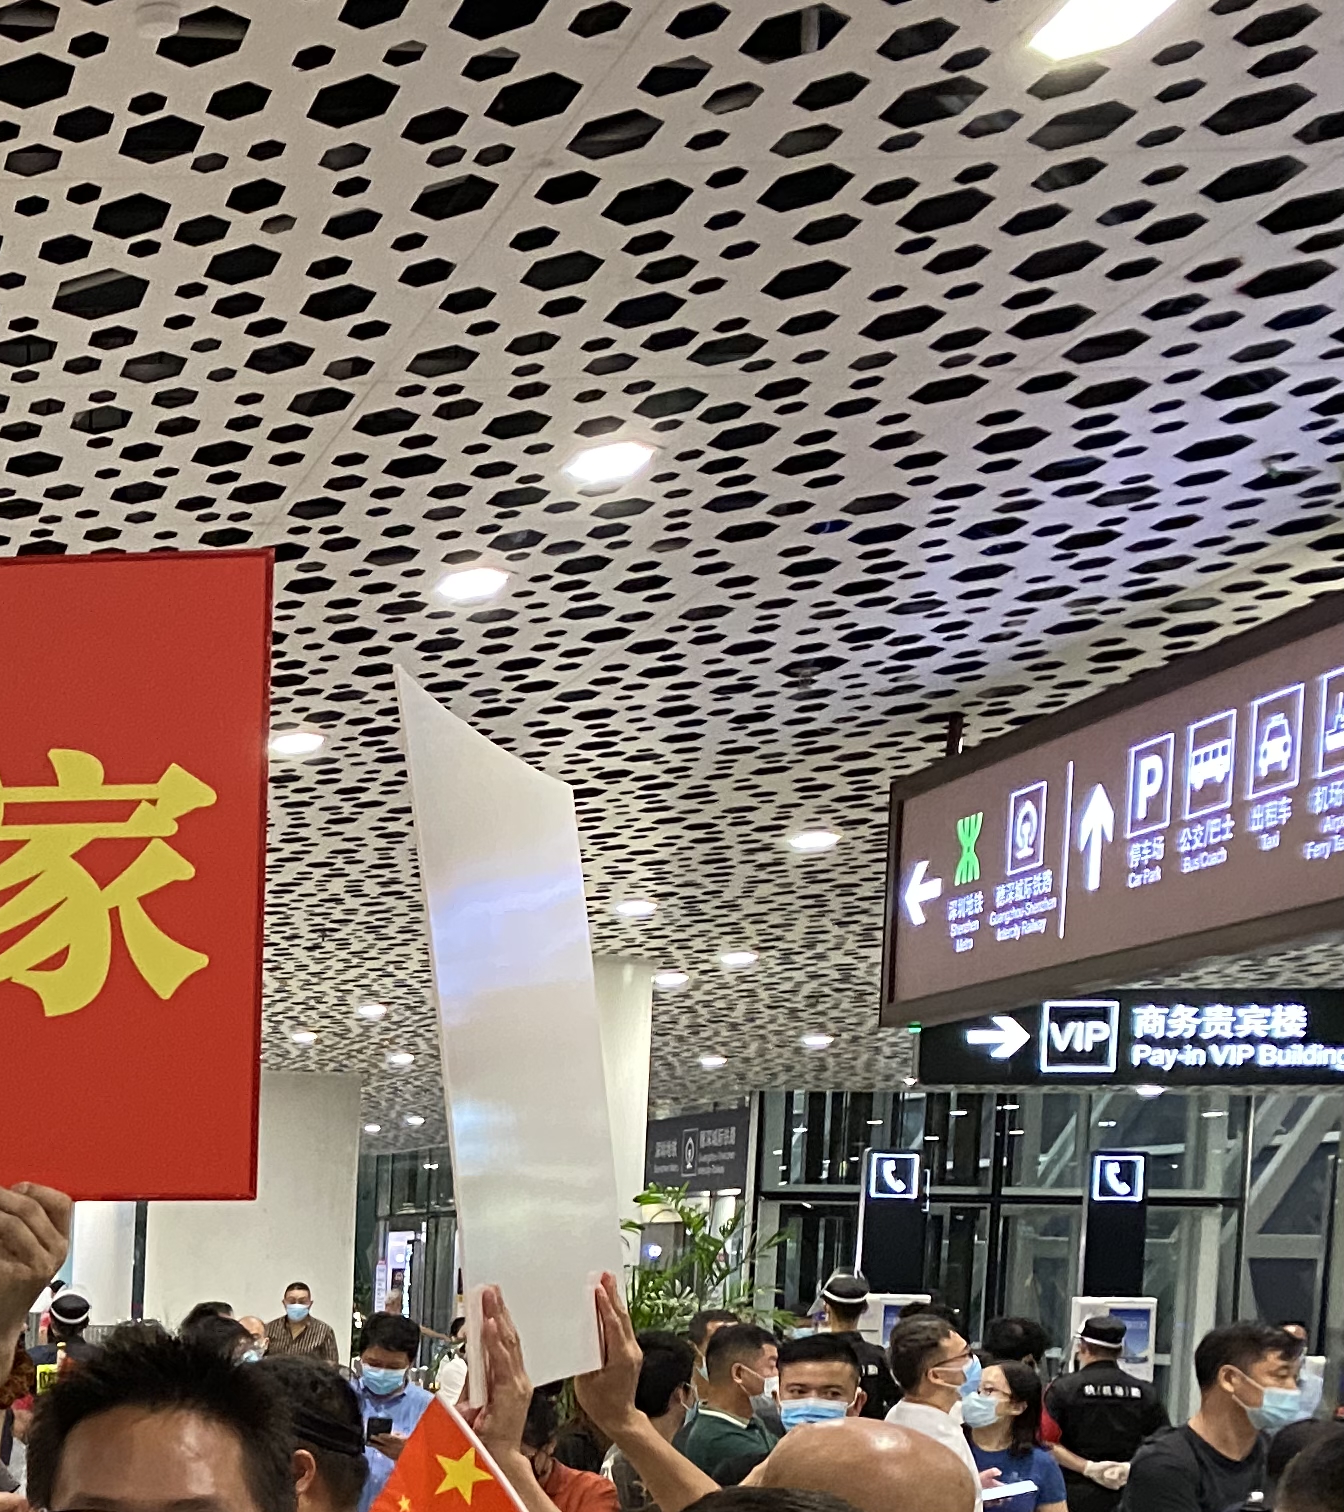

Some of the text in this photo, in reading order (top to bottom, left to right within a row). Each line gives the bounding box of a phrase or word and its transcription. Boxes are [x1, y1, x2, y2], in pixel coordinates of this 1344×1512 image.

[1178, 814, 1236, 853] 公交/巴士
[1049, 1020, 1111, 1052] VIP
[1133, 1003, 1308, 1040] 商务贵宾楼
[1133, 1043, 1207, 1071] Pay-in
[1210, 1043, 1255, 1067] VIP
